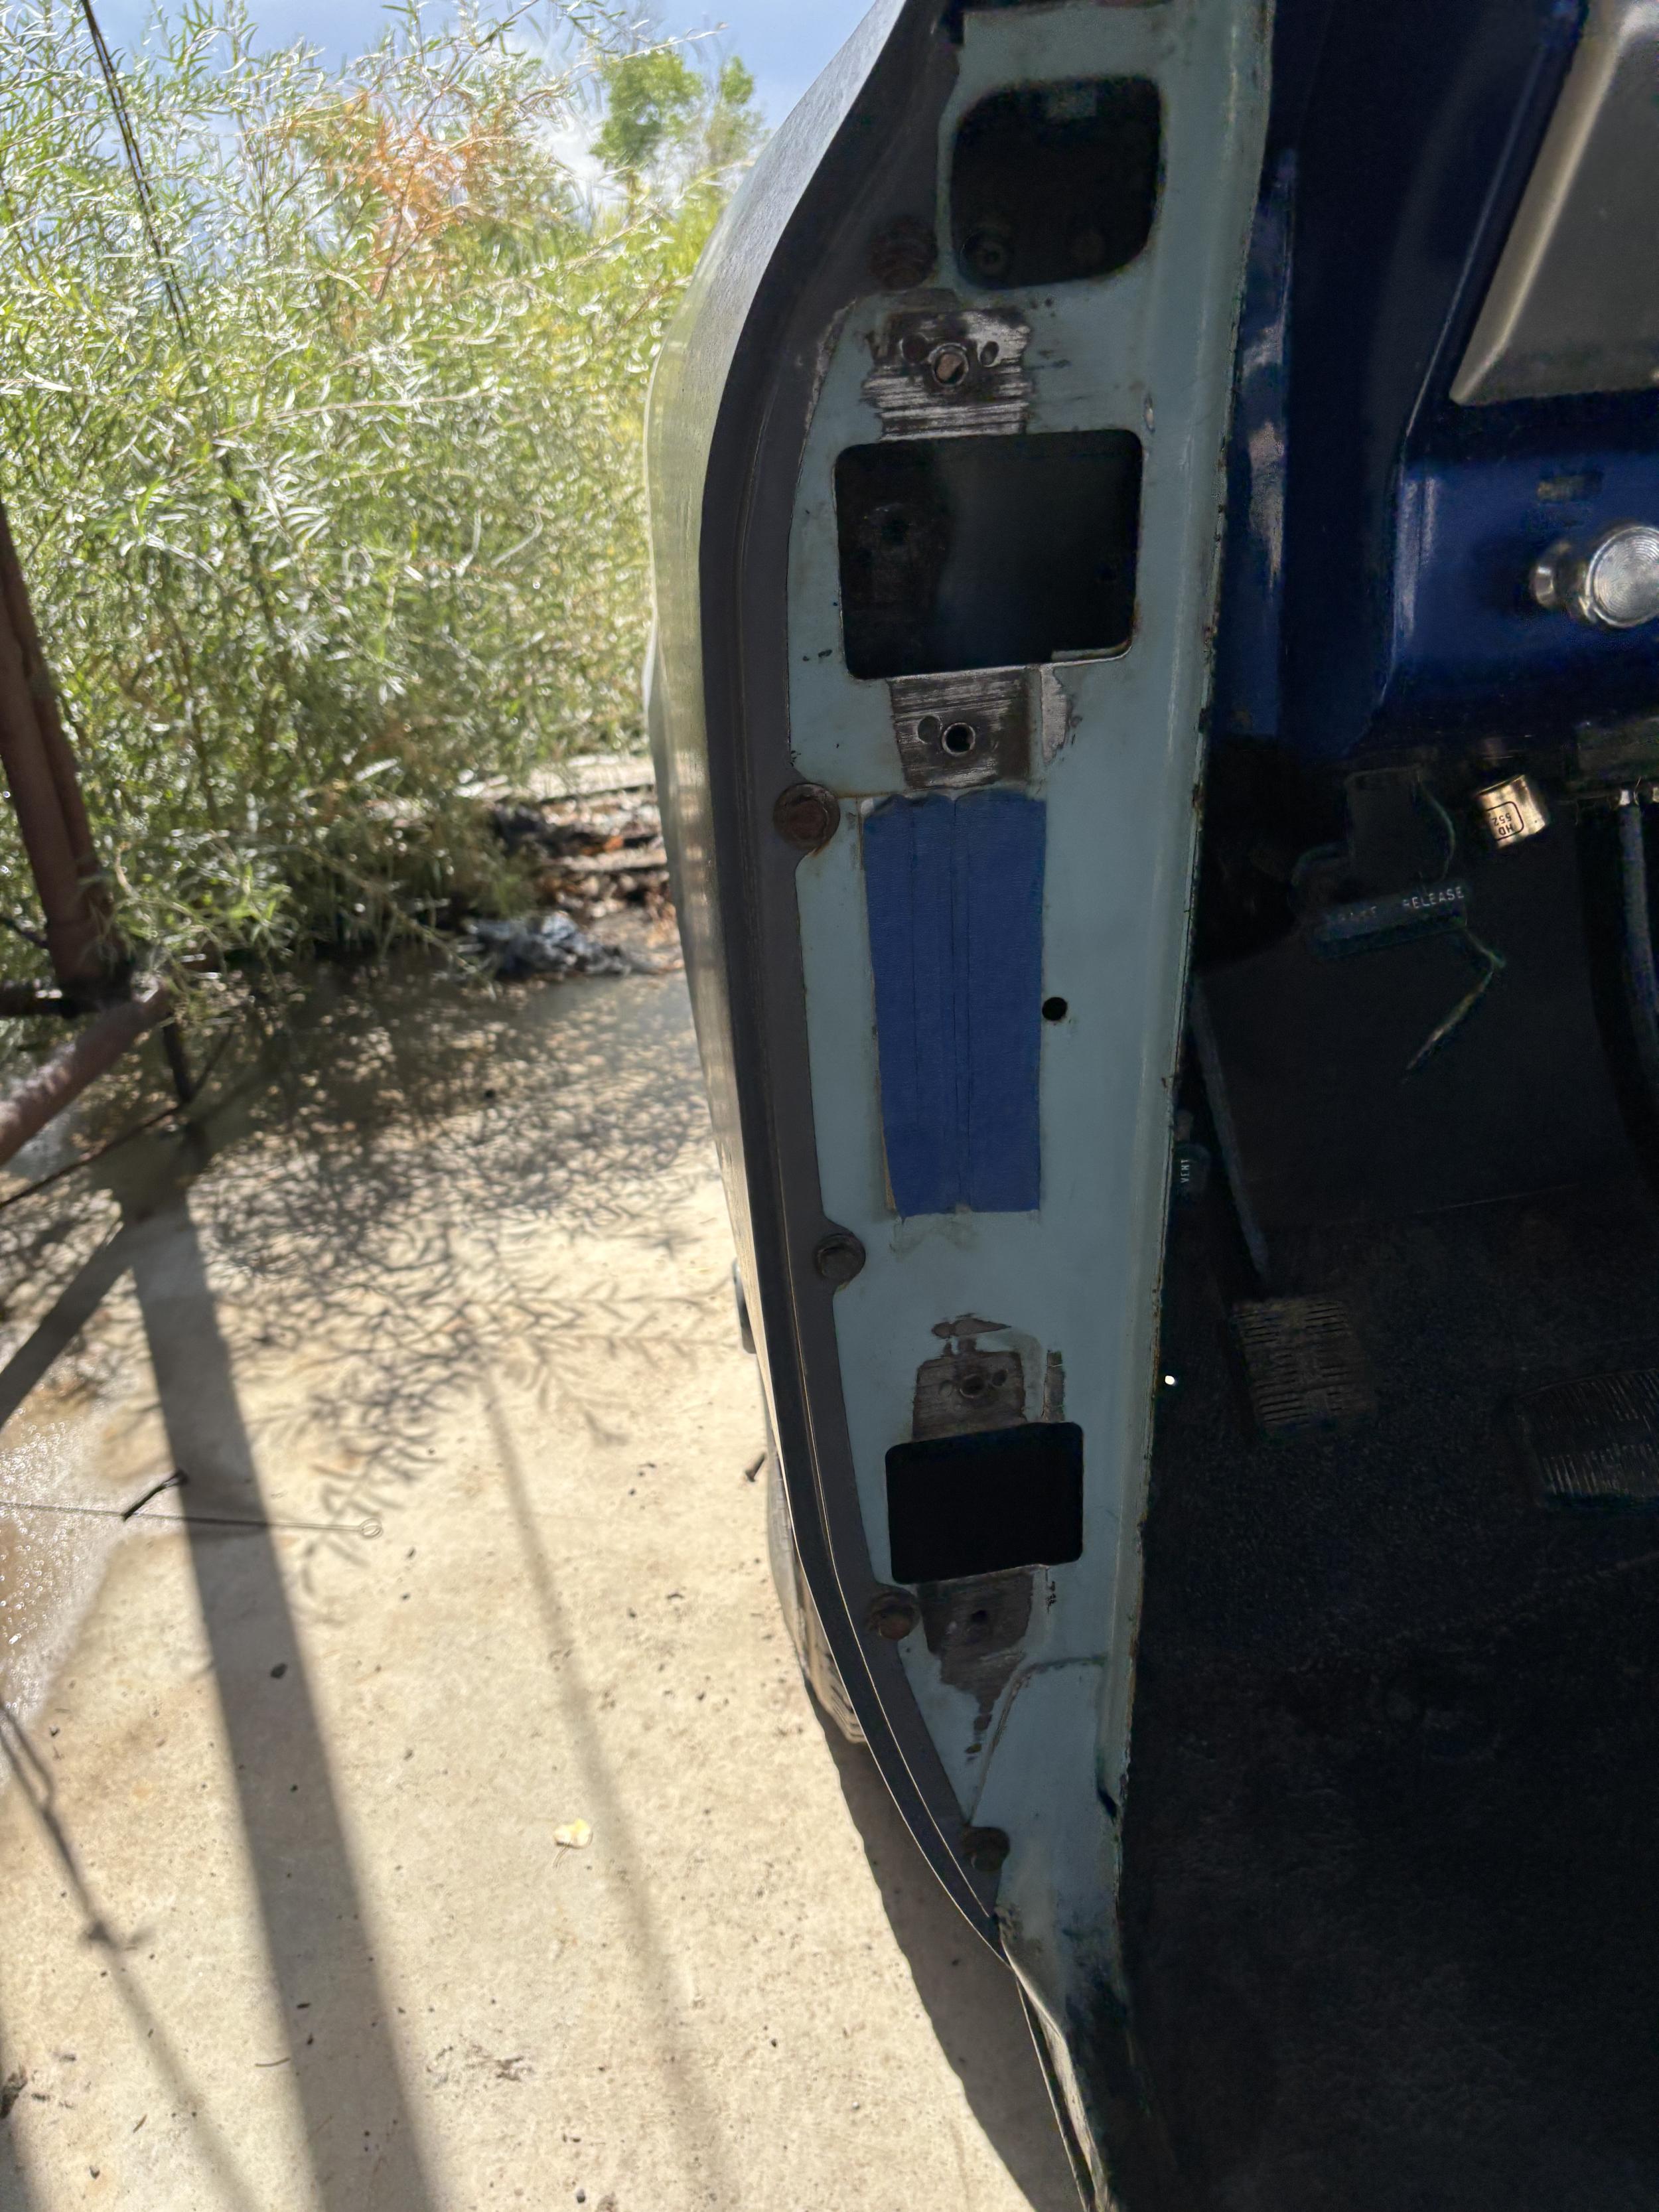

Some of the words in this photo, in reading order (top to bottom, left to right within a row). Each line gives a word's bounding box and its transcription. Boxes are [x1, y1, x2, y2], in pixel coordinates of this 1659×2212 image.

[1491, 812, 1512, 826] 552
[1498, 824, 1514, 836] HD
[1402, 886, 1465, 909] RELEASE
[1181, 1158, 1190, 1183] VENT
